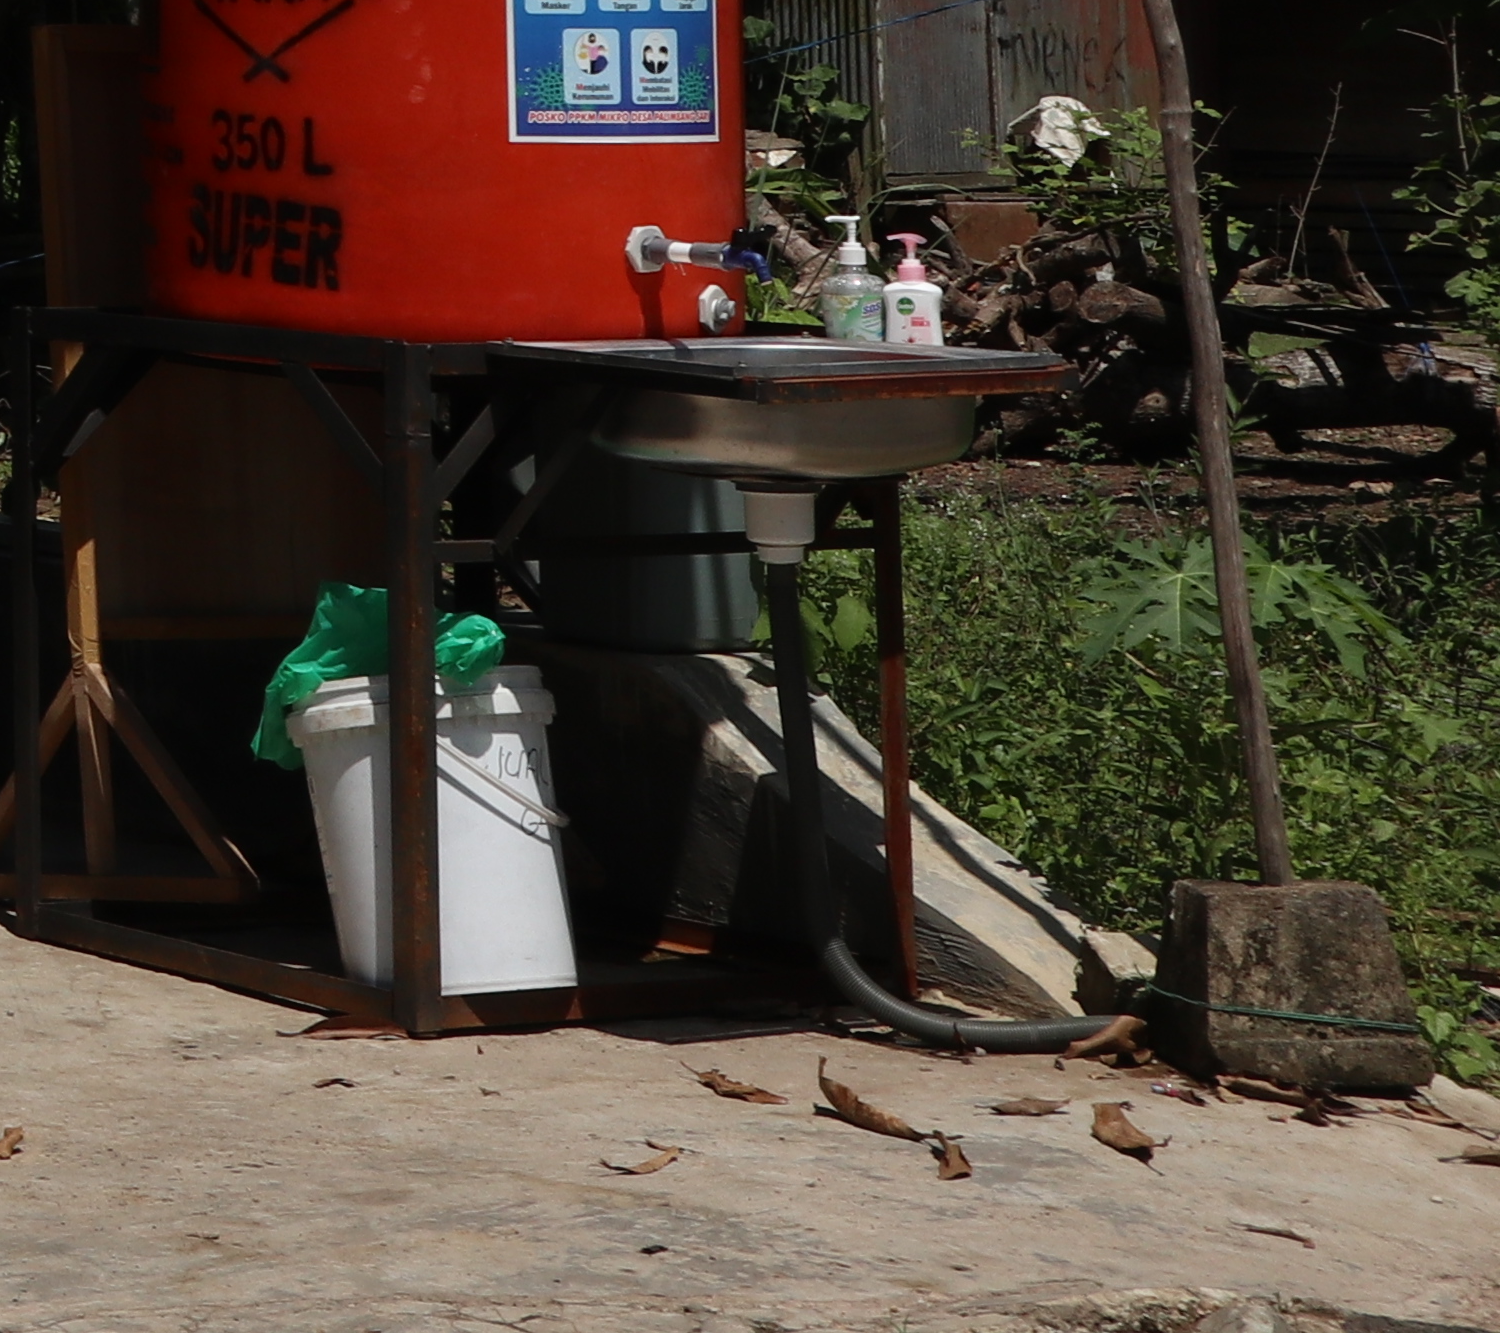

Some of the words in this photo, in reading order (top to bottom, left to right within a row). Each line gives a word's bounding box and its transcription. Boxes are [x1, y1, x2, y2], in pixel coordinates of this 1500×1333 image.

[541, 1, 571, 10] Masker
[528, 110, 566, 123] POSKO
[567, 110, 598, 123] PPKM
[598, 110, 631, 123] MIKRO
[210, 109, 286, 171] 350
[301, 116, 334, 176] L
[186, 181, 345, 291] SUPER
